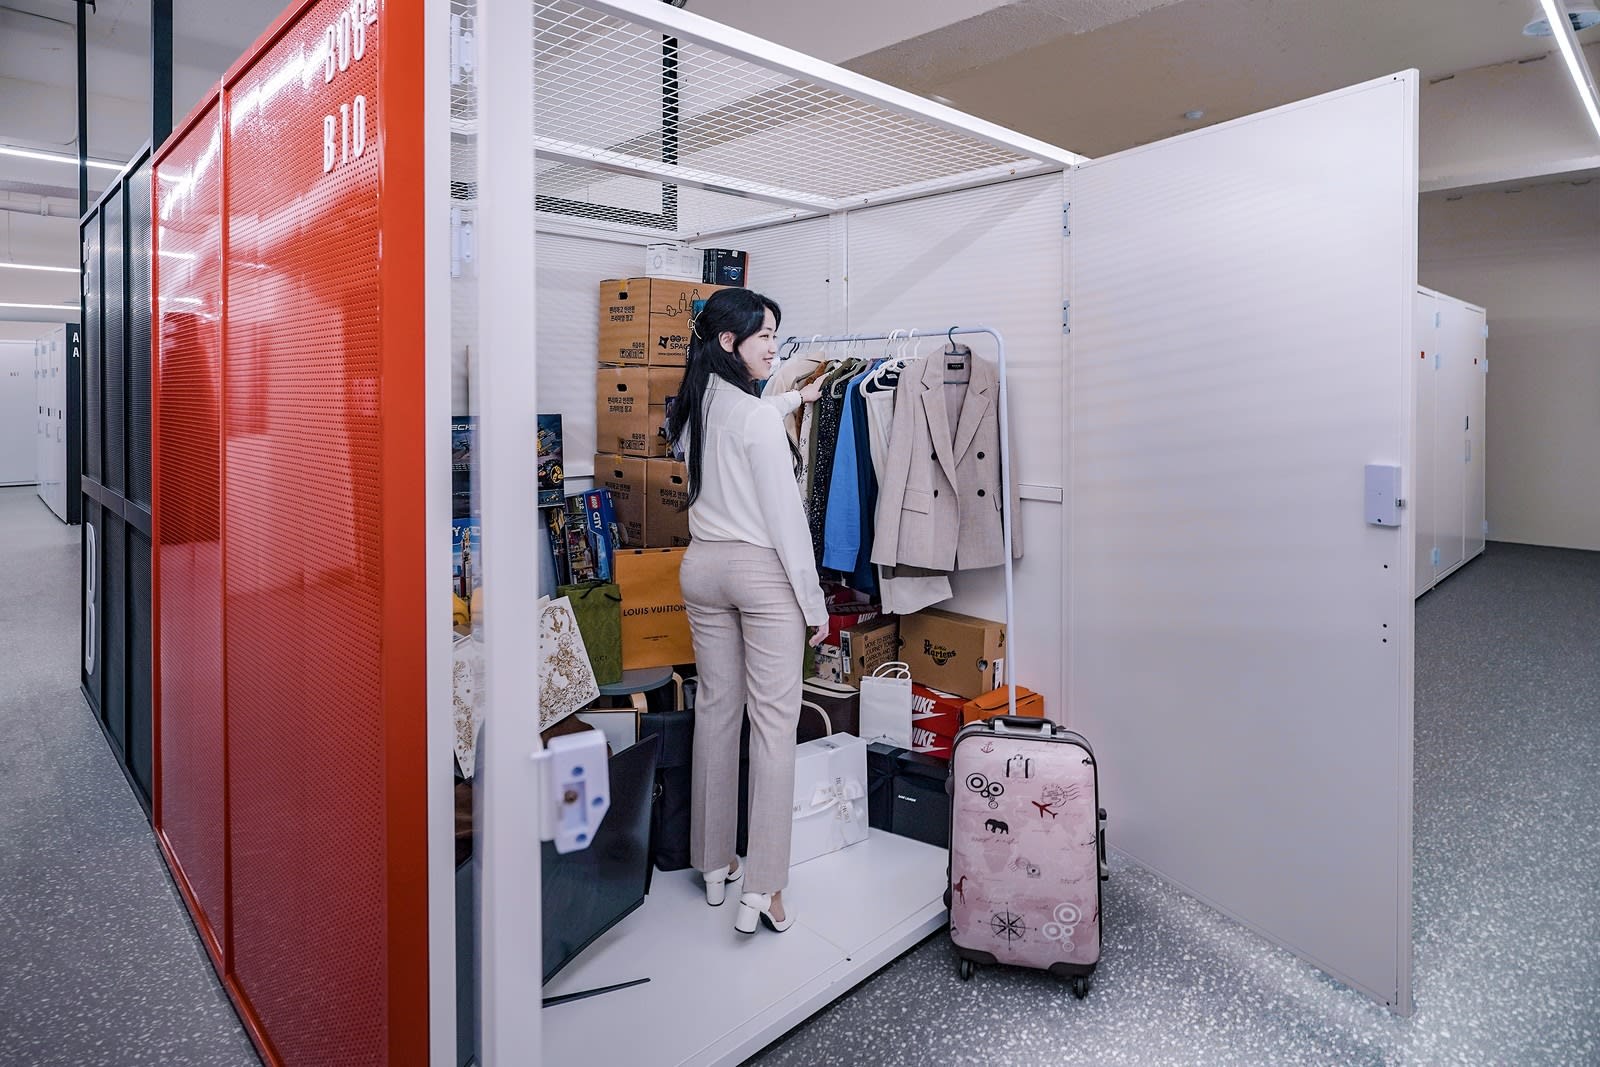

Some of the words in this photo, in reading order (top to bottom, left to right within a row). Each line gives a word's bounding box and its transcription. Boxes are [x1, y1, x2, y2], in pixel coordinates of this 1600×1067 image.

[323, 94, 366, 173] B10
[591, 495, 599, 509] LEGO
[592, 511, 603, 530] CITY
[623, 606, 649, 617] LOUIS
[651, 604, 687, 614] VUITTON
